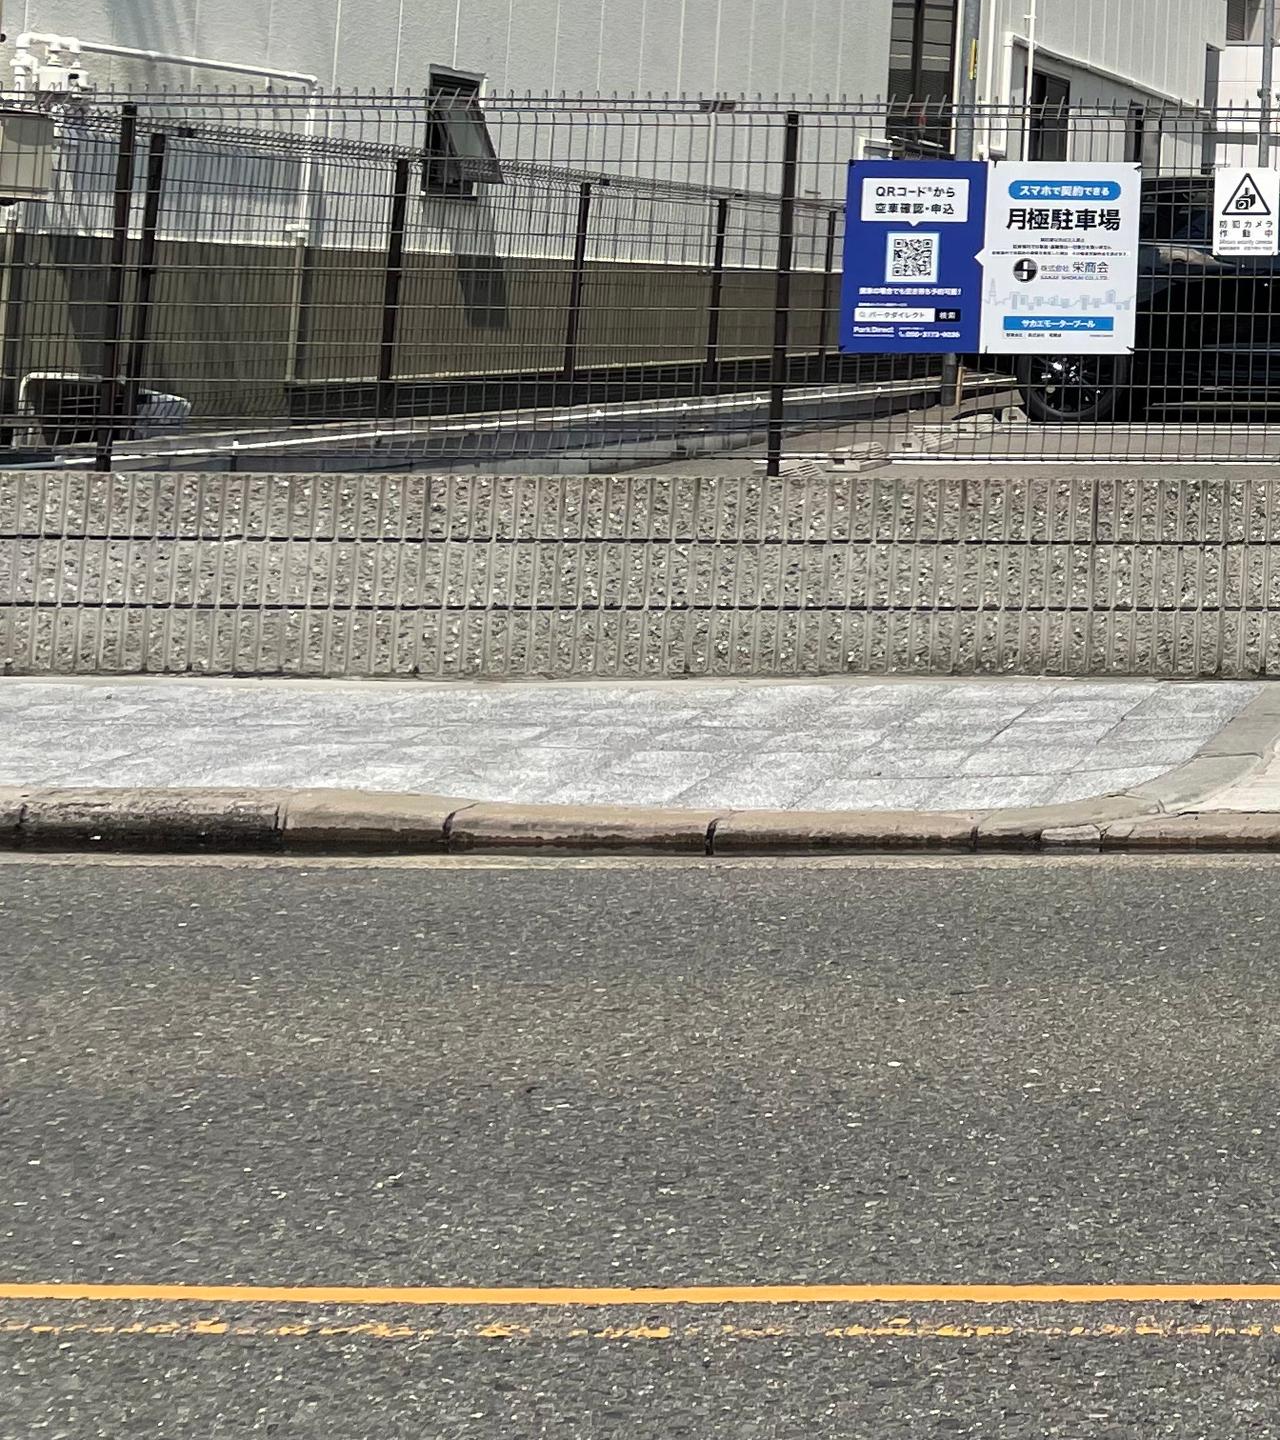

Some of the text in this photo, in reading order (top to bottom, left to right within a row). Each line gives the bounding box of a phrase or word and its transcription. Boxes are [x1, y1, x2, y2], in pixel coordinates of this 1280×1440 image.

[1019, 185, 1110, 197] スマホで契約できる
[874, 203, 955, 215] 空車確認・申込
[1006, 208, 1121, 231] 月極駐車場
[1219, 220, 1273, 229] 防犯カメラ
[1072, 261, 1109, 273] 栄商会
[1021, 320, 1096, 328] サカエモータープール
